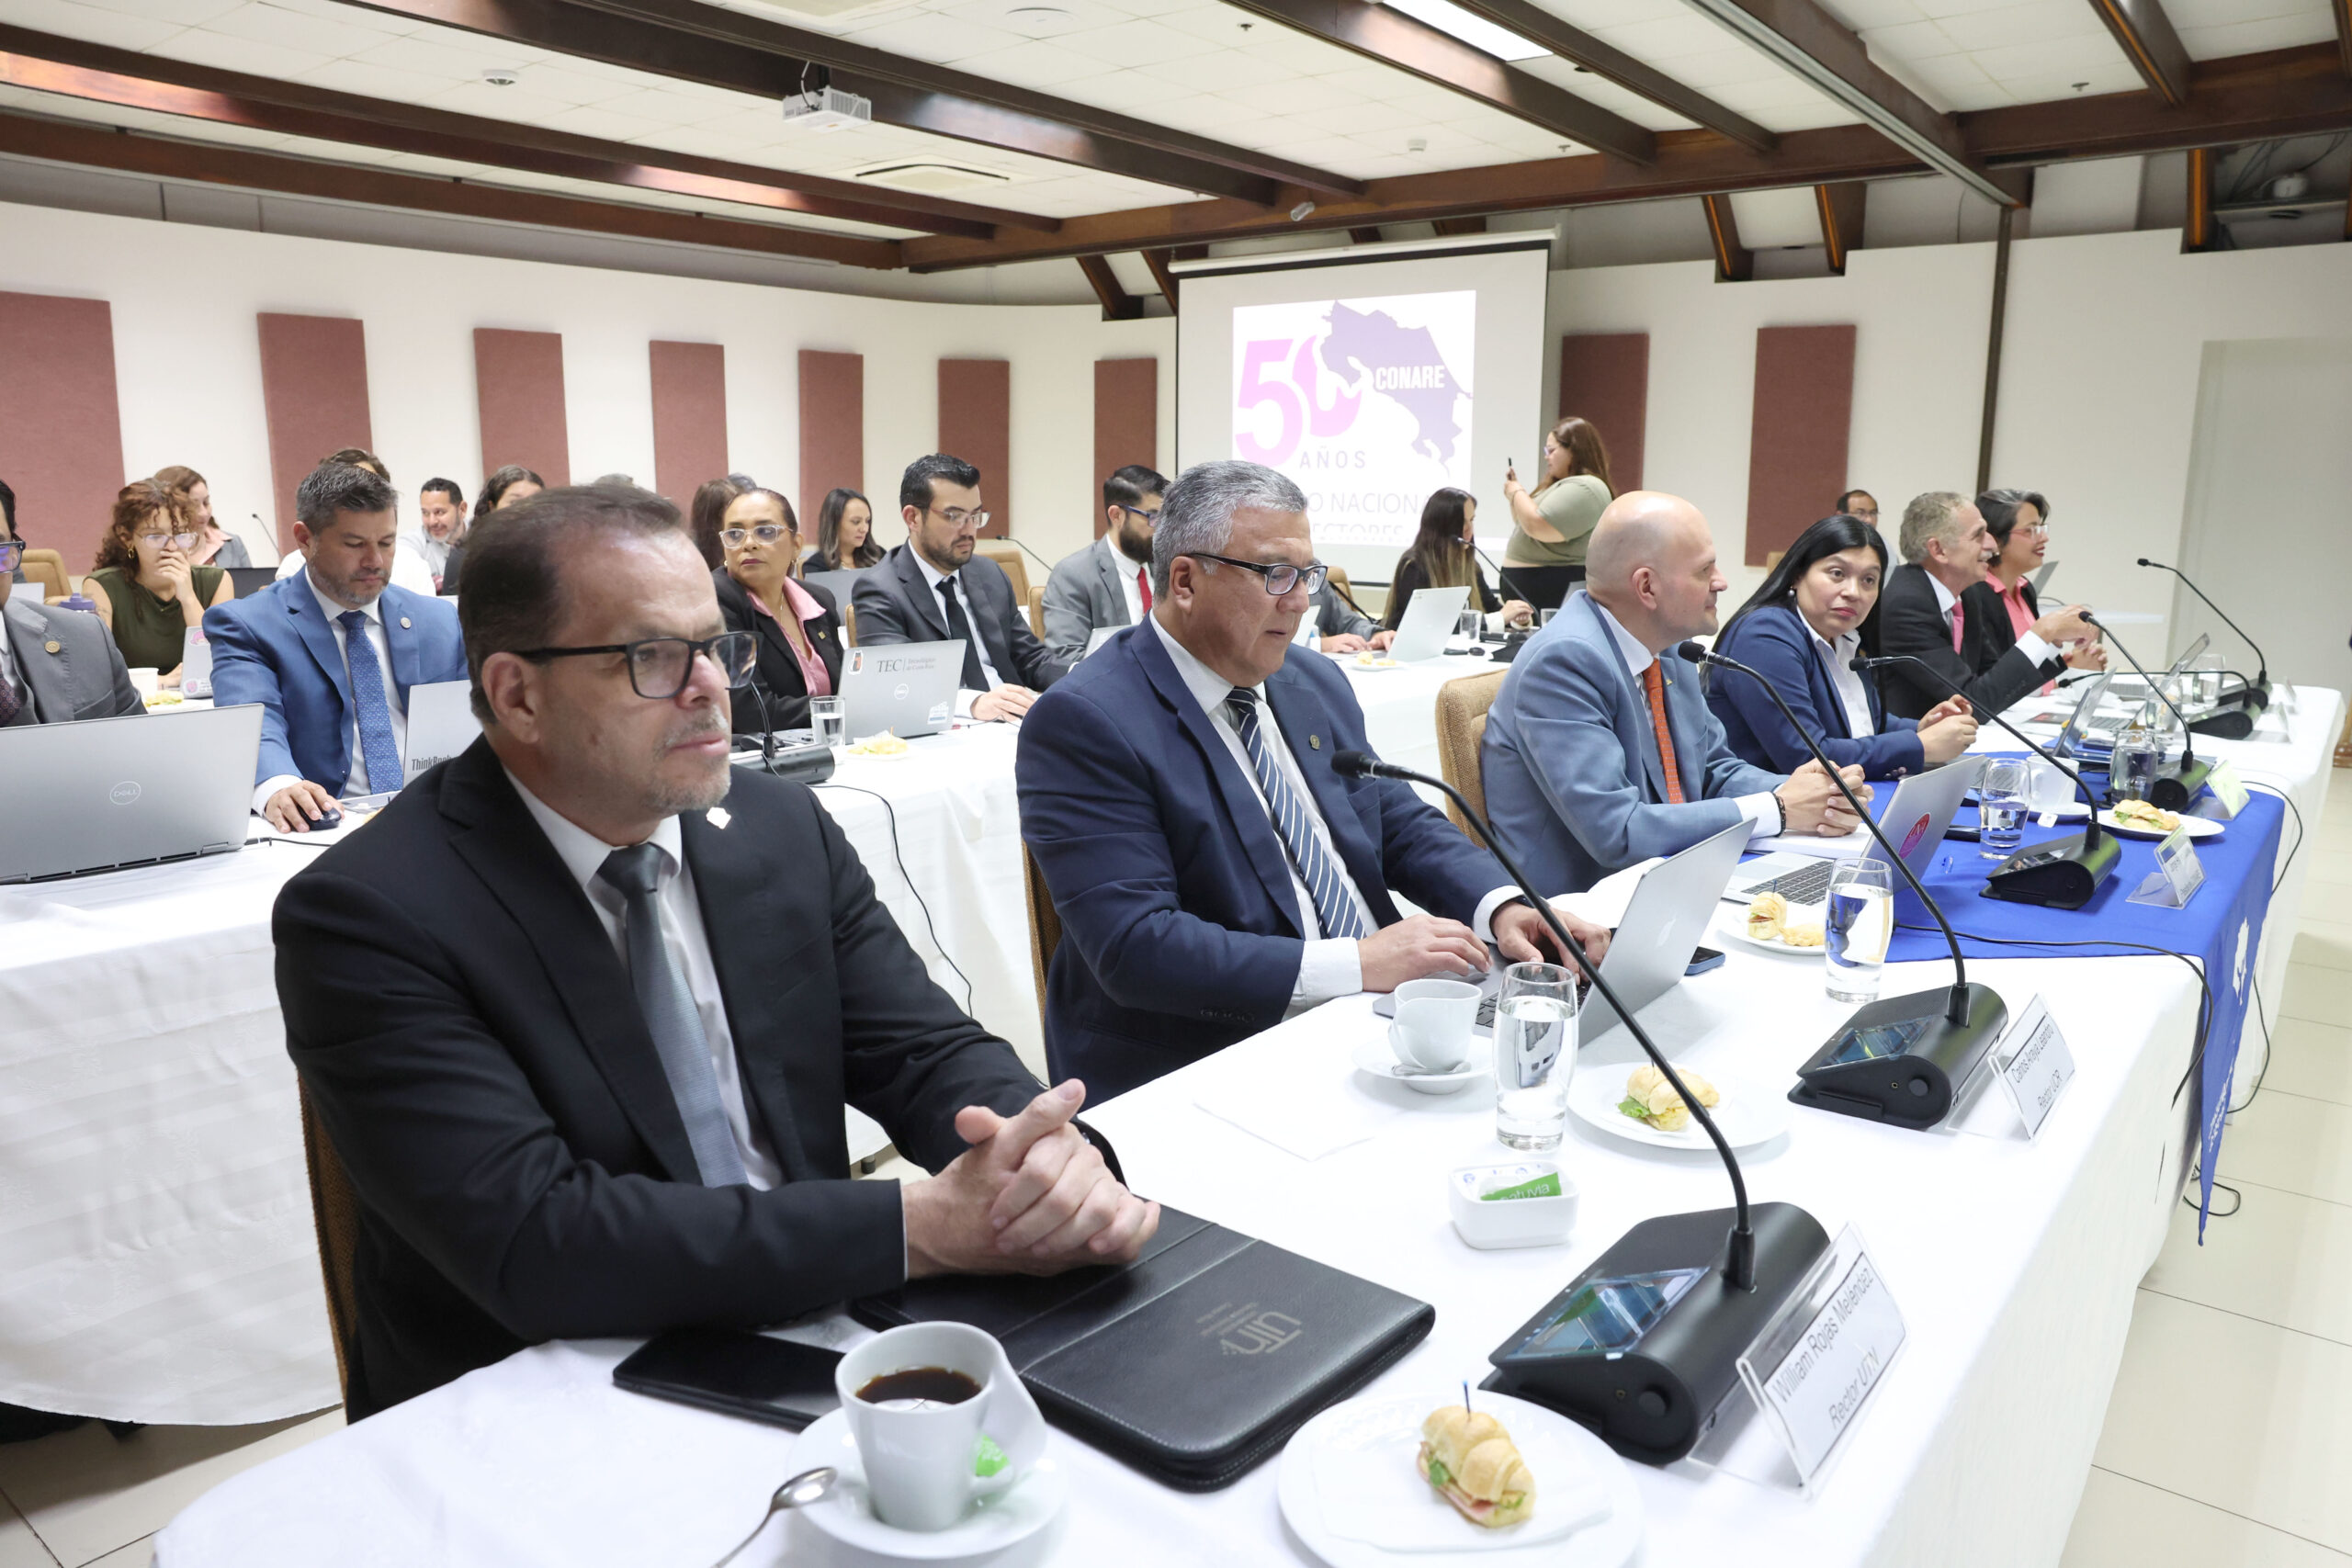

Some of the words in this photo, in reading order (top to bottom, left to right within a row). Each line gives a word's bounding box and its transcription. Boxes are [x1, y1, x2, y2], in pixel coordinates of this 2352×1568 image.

[1375, 365, 1445, 389] CONARE
[1299, 445, 1366, 469] AÑOS
[877, 659, 902, 672] TEC
[1771, 1350, 1815, 1404] William
[1806, 1316, 1839, 1359] Rojas
[1828, 1377, 1860, 1430] Rector
[1857, 1346, 1880, 1386] UTN
